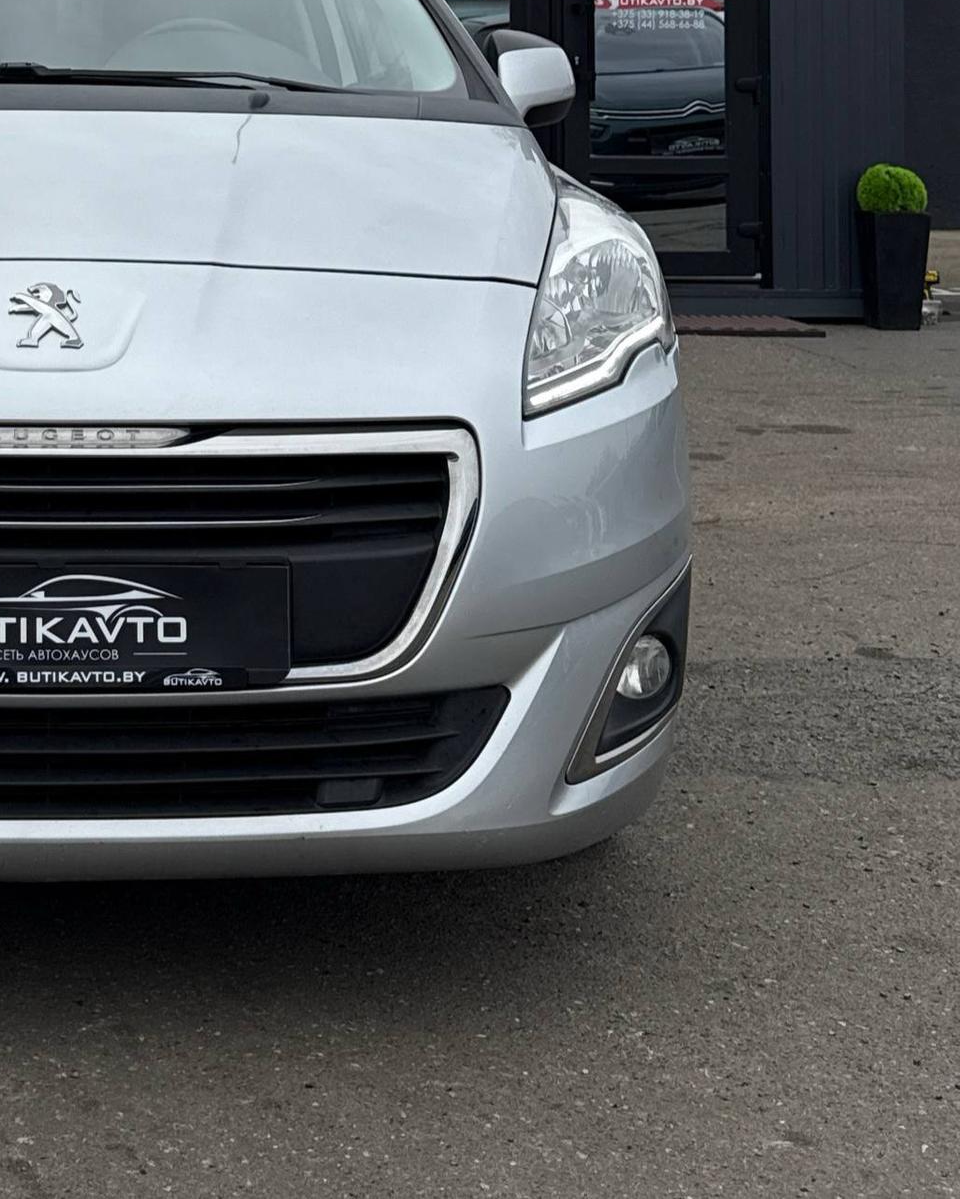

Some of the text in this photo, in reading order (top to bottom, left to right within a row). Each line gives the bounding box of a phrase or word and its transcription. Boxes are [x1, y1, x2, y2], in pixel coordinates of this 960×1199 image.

[612, 9, 635, 19] +375
[612, 20, 635, 29] +375
[637, 19, 656, 31] (44)
[27, 649, 119, 661] АВТОХАУСОВ
[16, 671, 147, 683] BUTIKAVTO.BY
[163, 677, 223, 686] BUTIKAVTO
